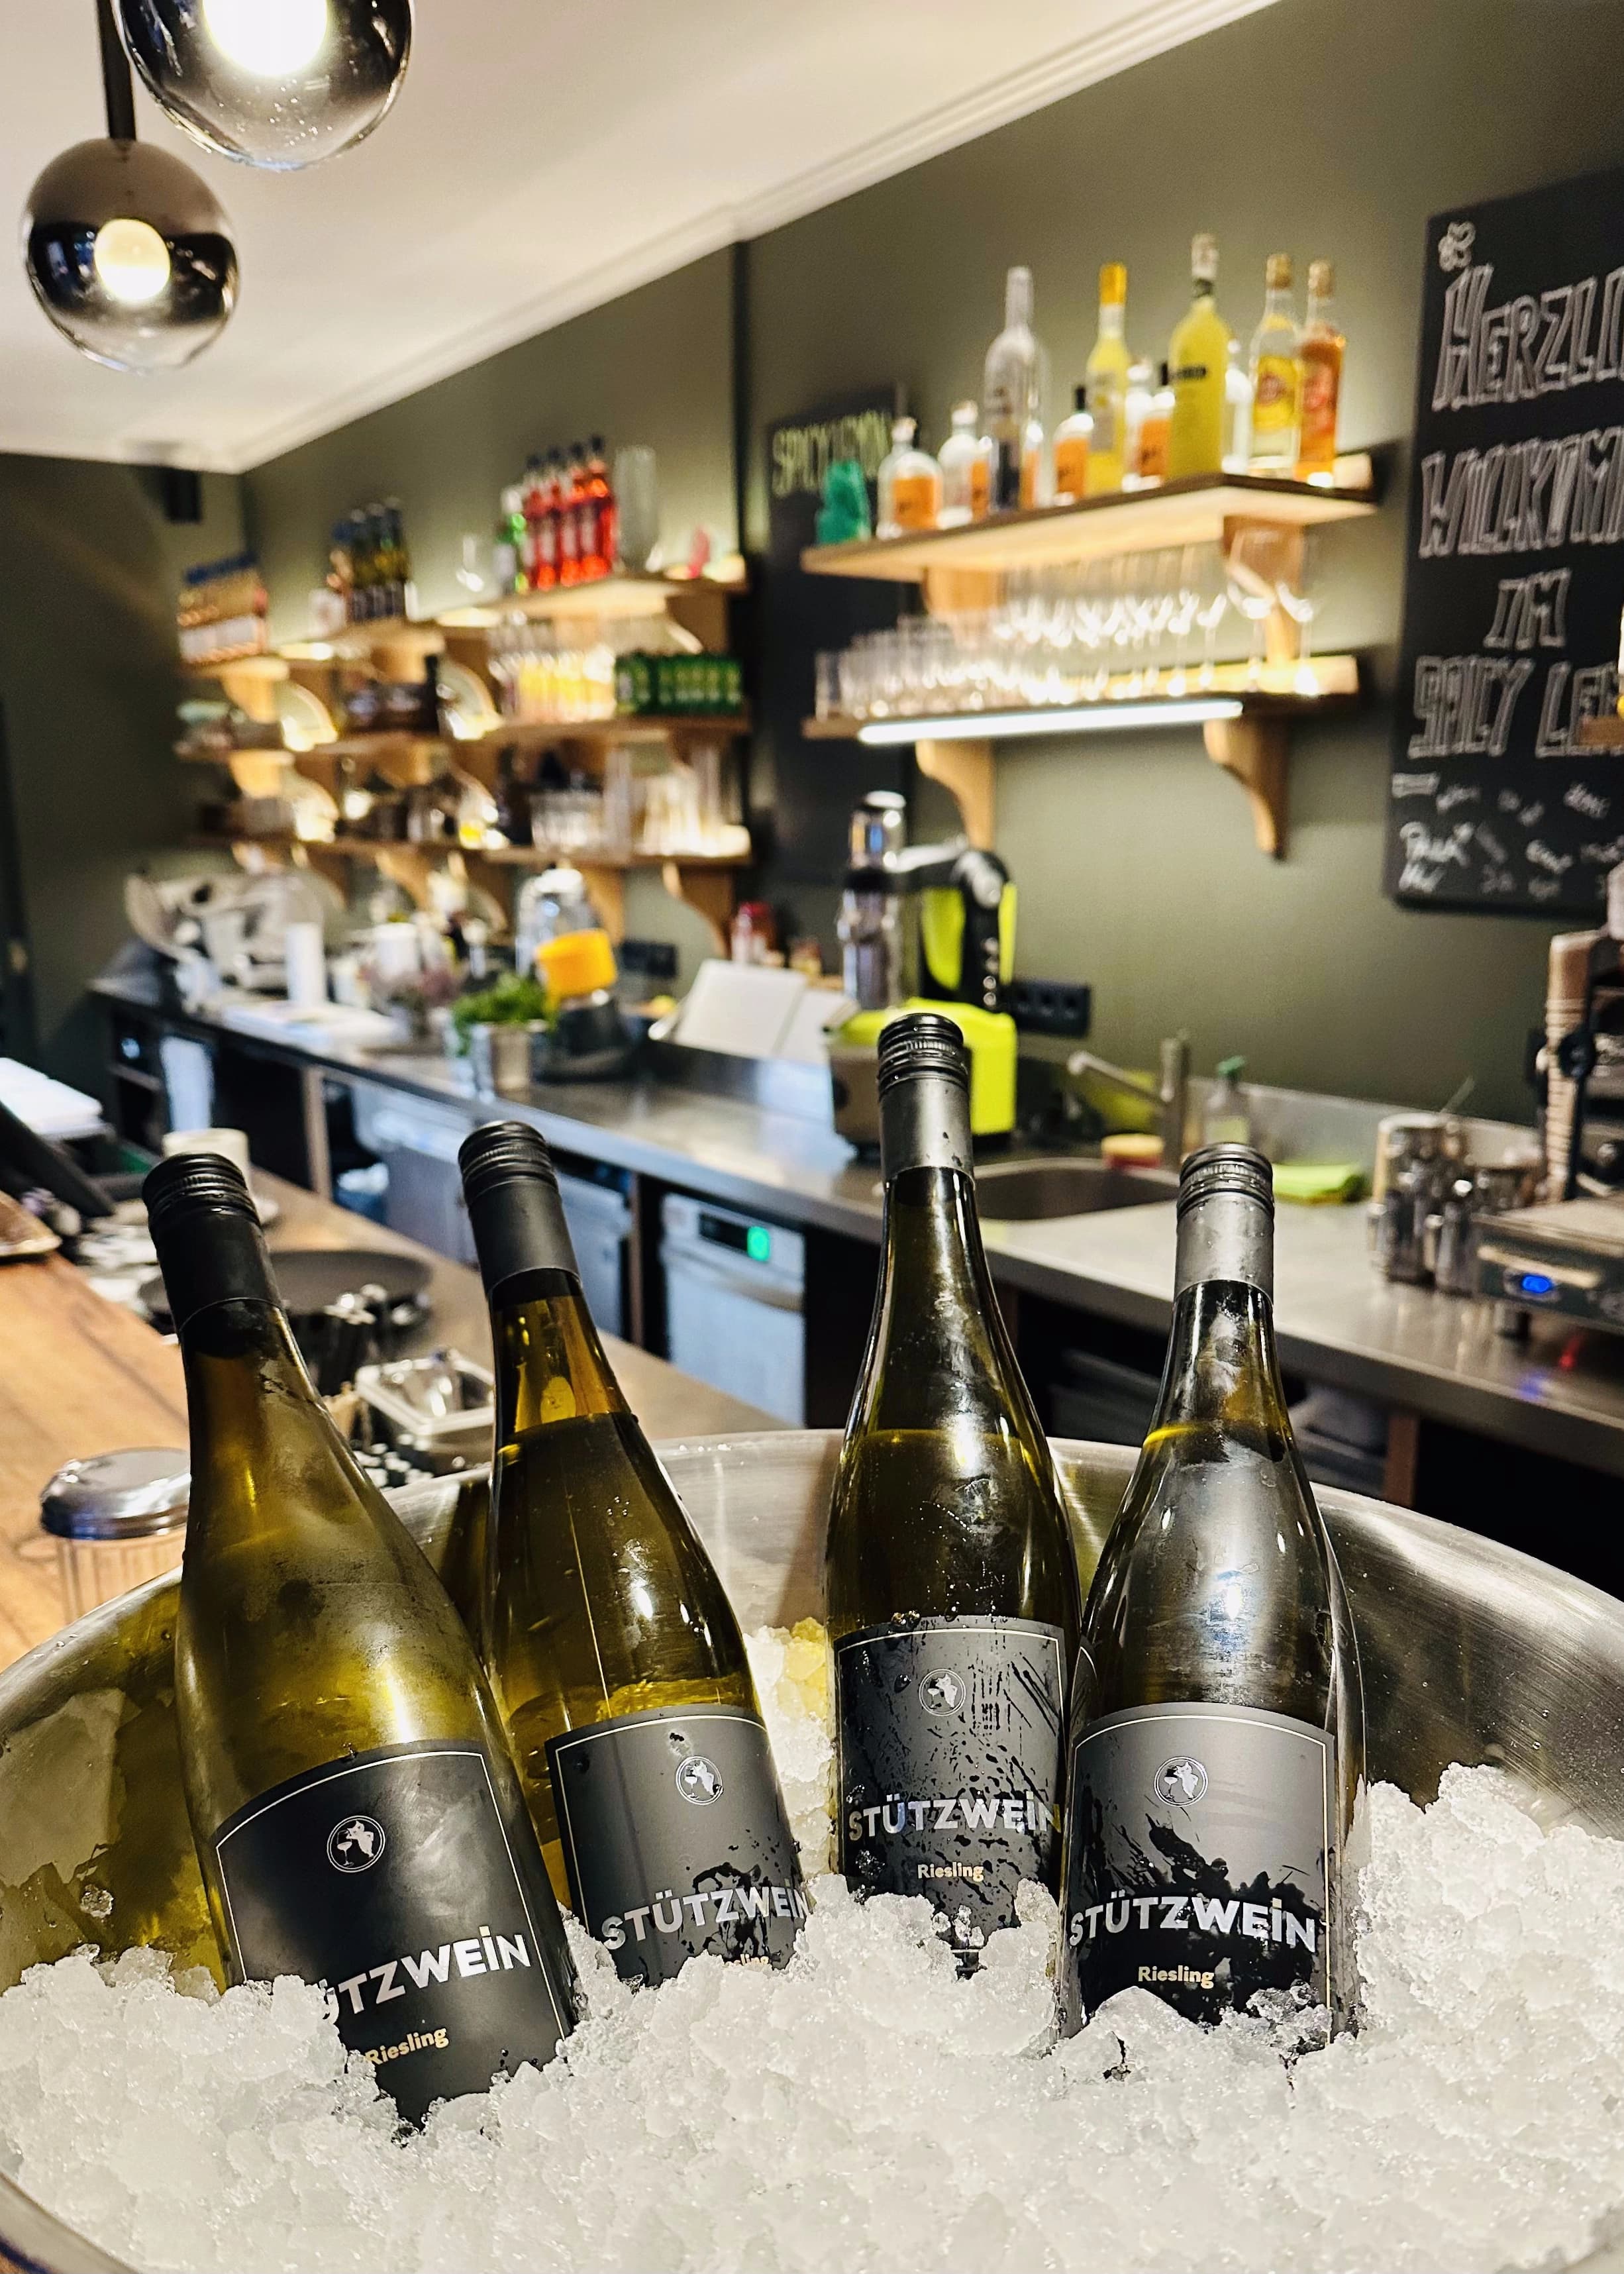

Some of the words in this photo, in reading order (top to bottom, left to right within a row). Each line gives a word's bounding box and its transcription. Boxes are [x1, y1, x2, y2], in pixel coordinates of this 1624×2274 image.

[917, 1861, 984, 1882] Riesling
[1137, 1965, 1215, 1989] Riesling
[365, 2027, 450, 2065] Riesling
